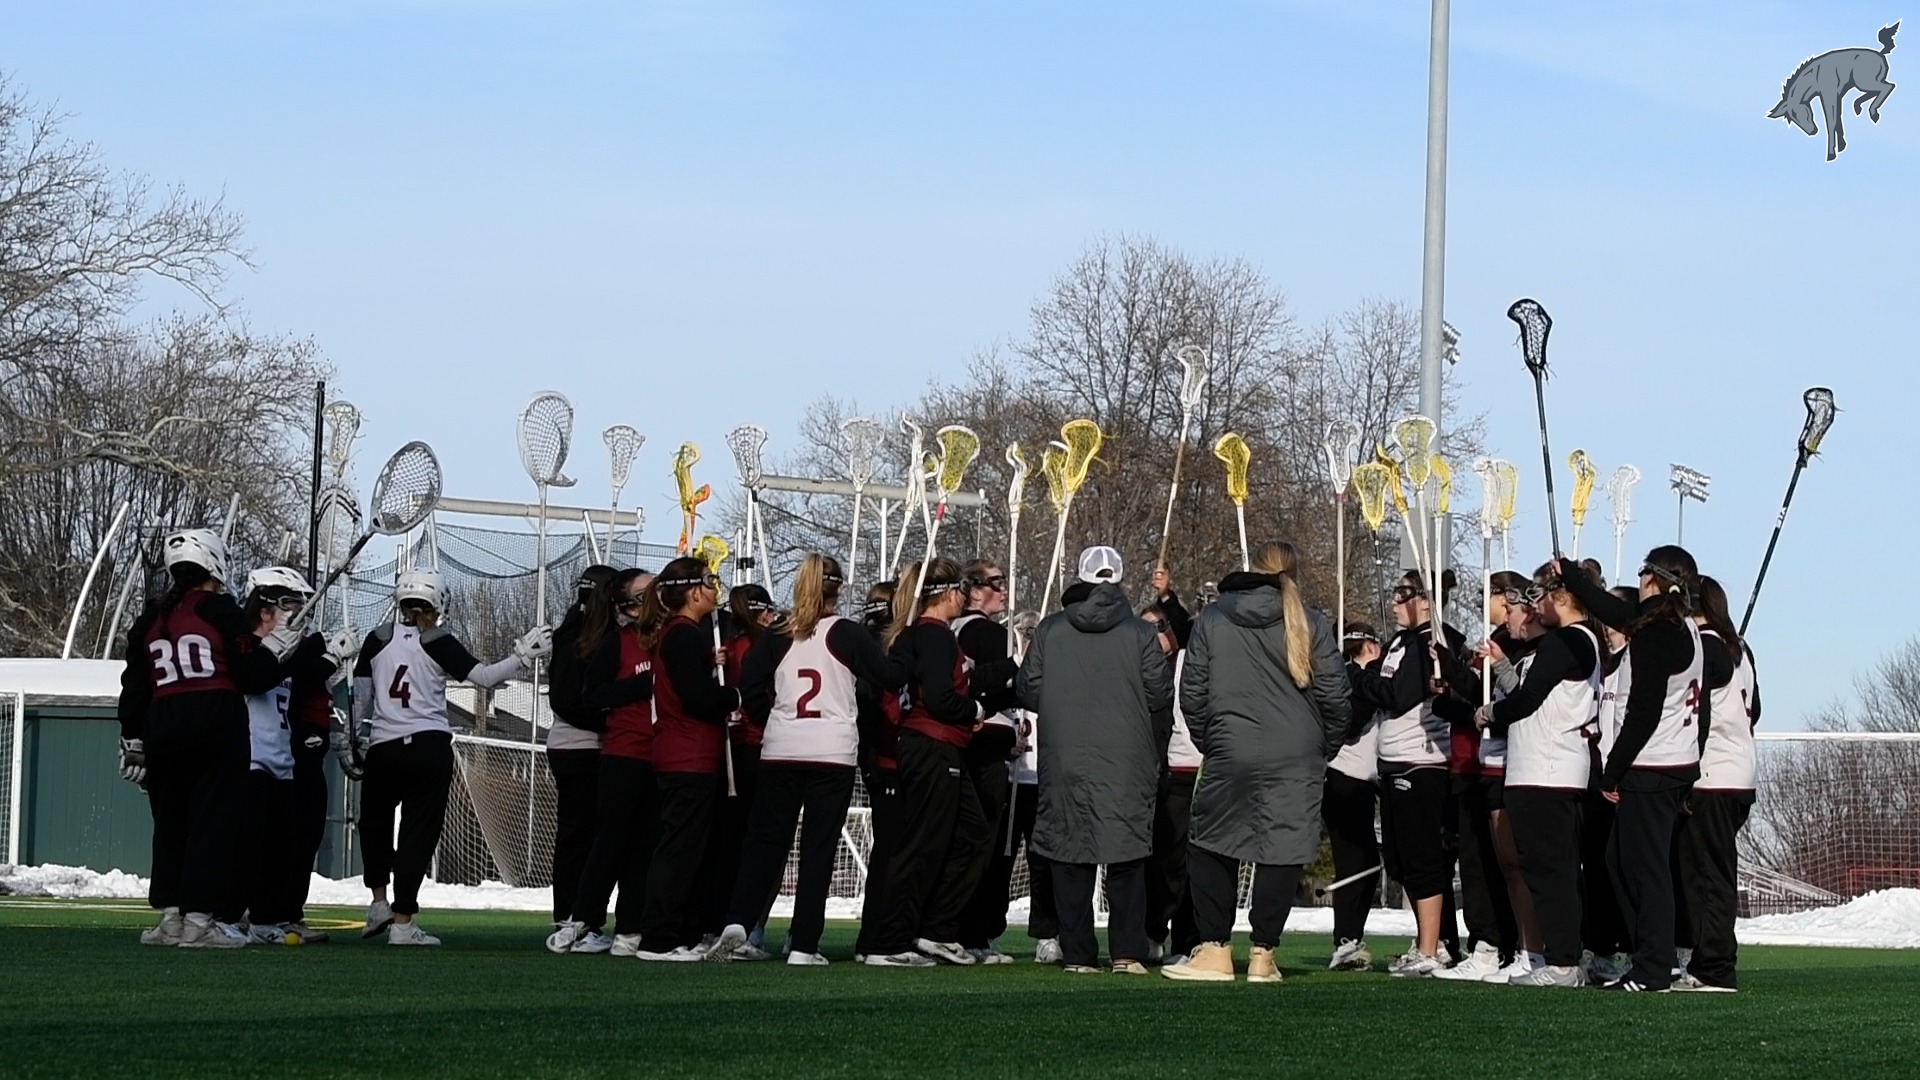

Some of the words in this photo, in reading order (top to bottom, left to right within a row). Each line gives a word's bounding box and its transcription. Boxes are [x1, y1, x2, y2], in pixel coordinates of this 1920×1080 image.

[149, 634, 215, 687] 30
[389, 664, 411, 708] 4
[796, 667, 822, 719] 2
[276, 693, 290, 730] 5
